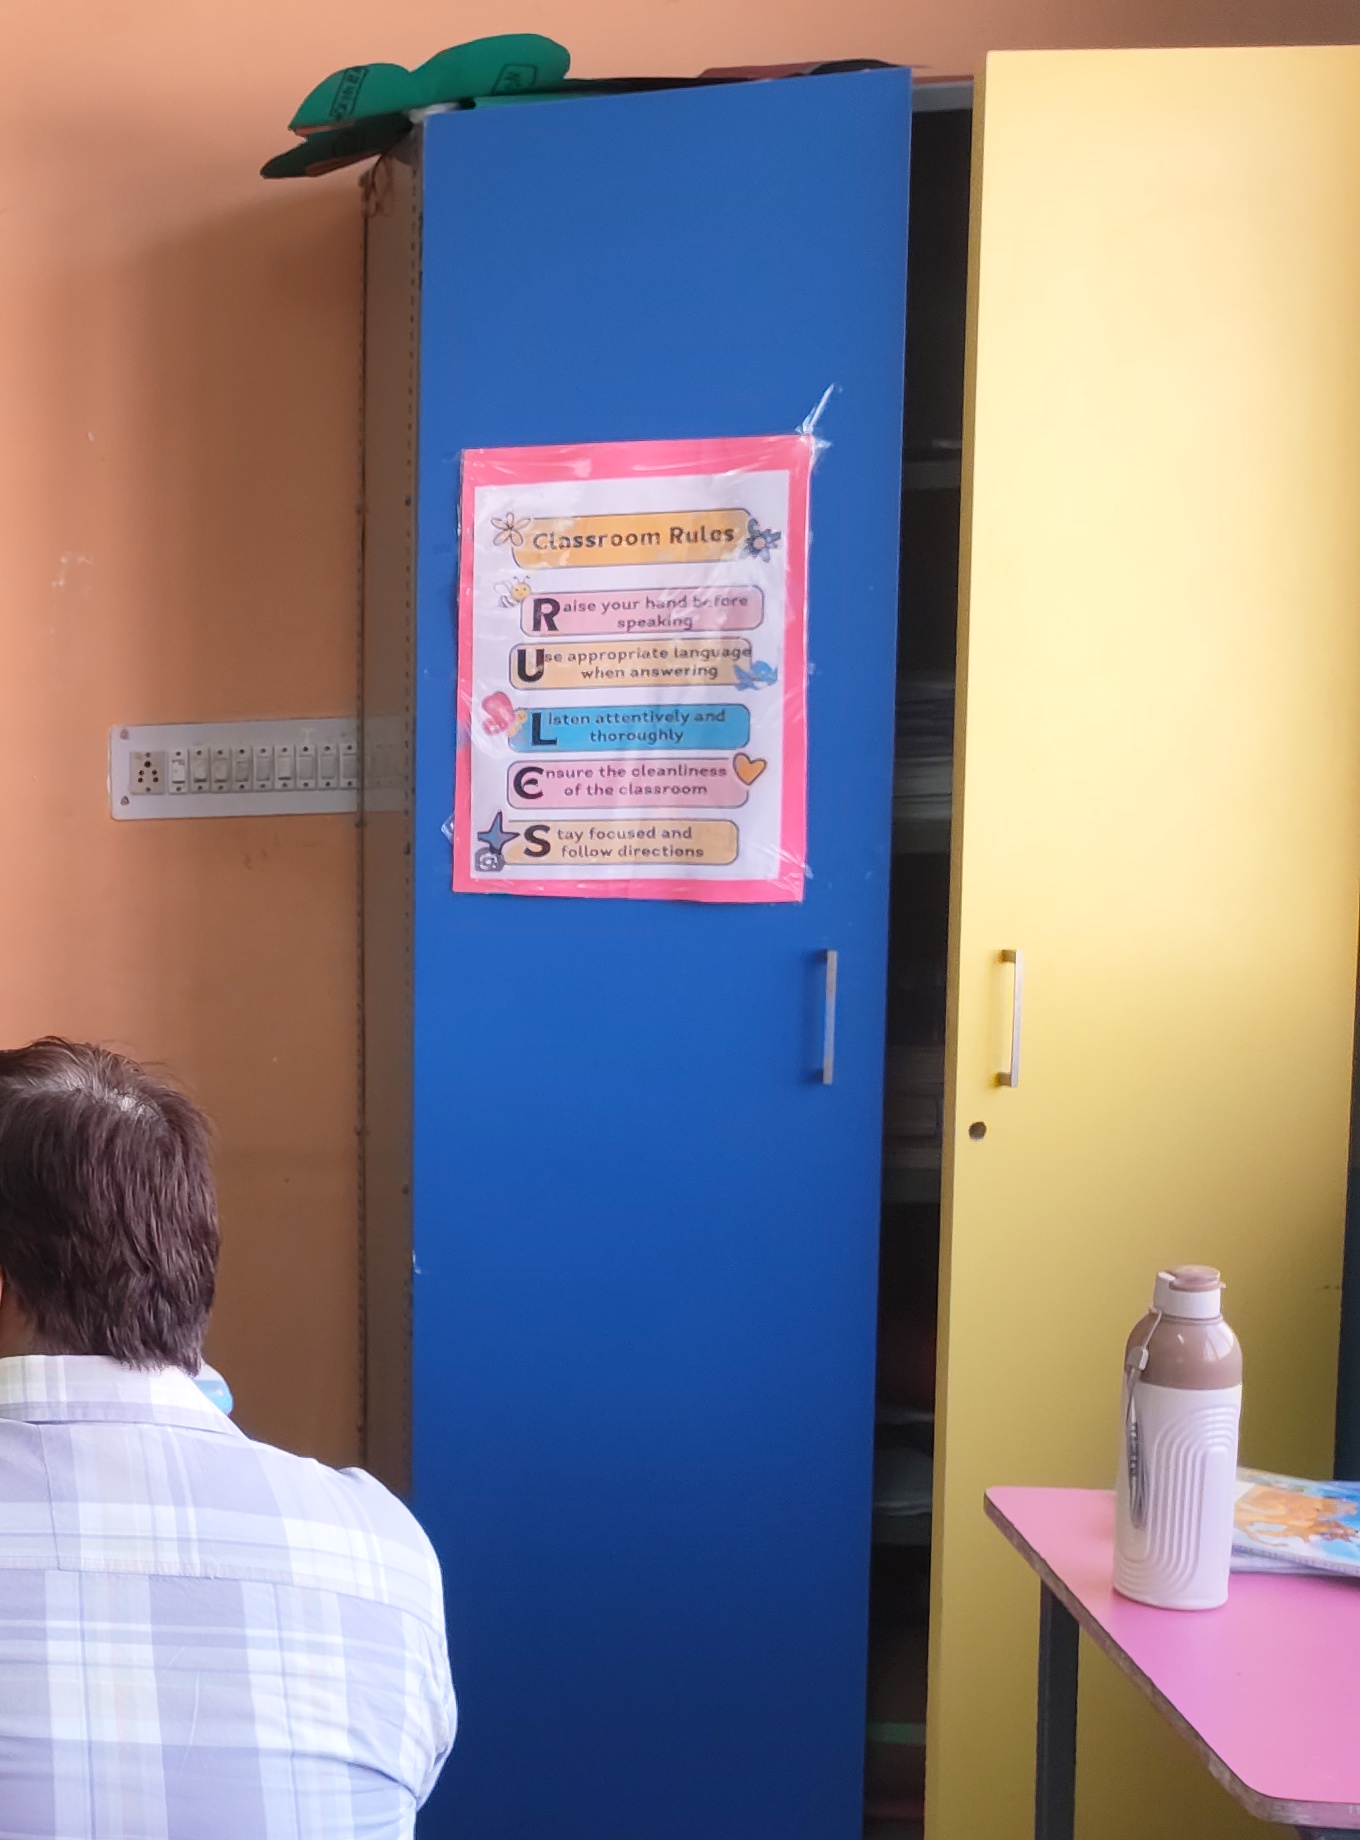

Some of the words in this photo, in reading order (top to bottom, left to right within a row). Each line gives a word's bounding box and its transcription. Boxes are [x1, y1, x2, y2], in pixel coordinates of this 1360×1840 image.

[532, 531, 661, 550] Classroom
[669, 525, 735, 544] Rules
[601, 600, 640, 615] your
[645, 595, 687, 610] hand
[617, 614, 694, 632] speaking
[567, 646, 669, 664] appropriate
[674, 645, 752, 661] language
[580, 665, 625, 680] when
[630, 665, 718, 681] answering
[595, 710, 689, 726] attentively
[694, 709, 726, 722] and
[590, 727, 684, 743] thoroughly
[600, 765, 626, 778] the
[631, 763, 727, 778] cleanliness
[564, 783, 581, 796] of
[587, 783, 614, 796] the
[619, 784, 708, 796] classroom
[589, 827, 656, 840] focused
[661, 827, 693, 840] and
[561, 845, 613, 858] follow
[618, 846, 705, 858] directions
